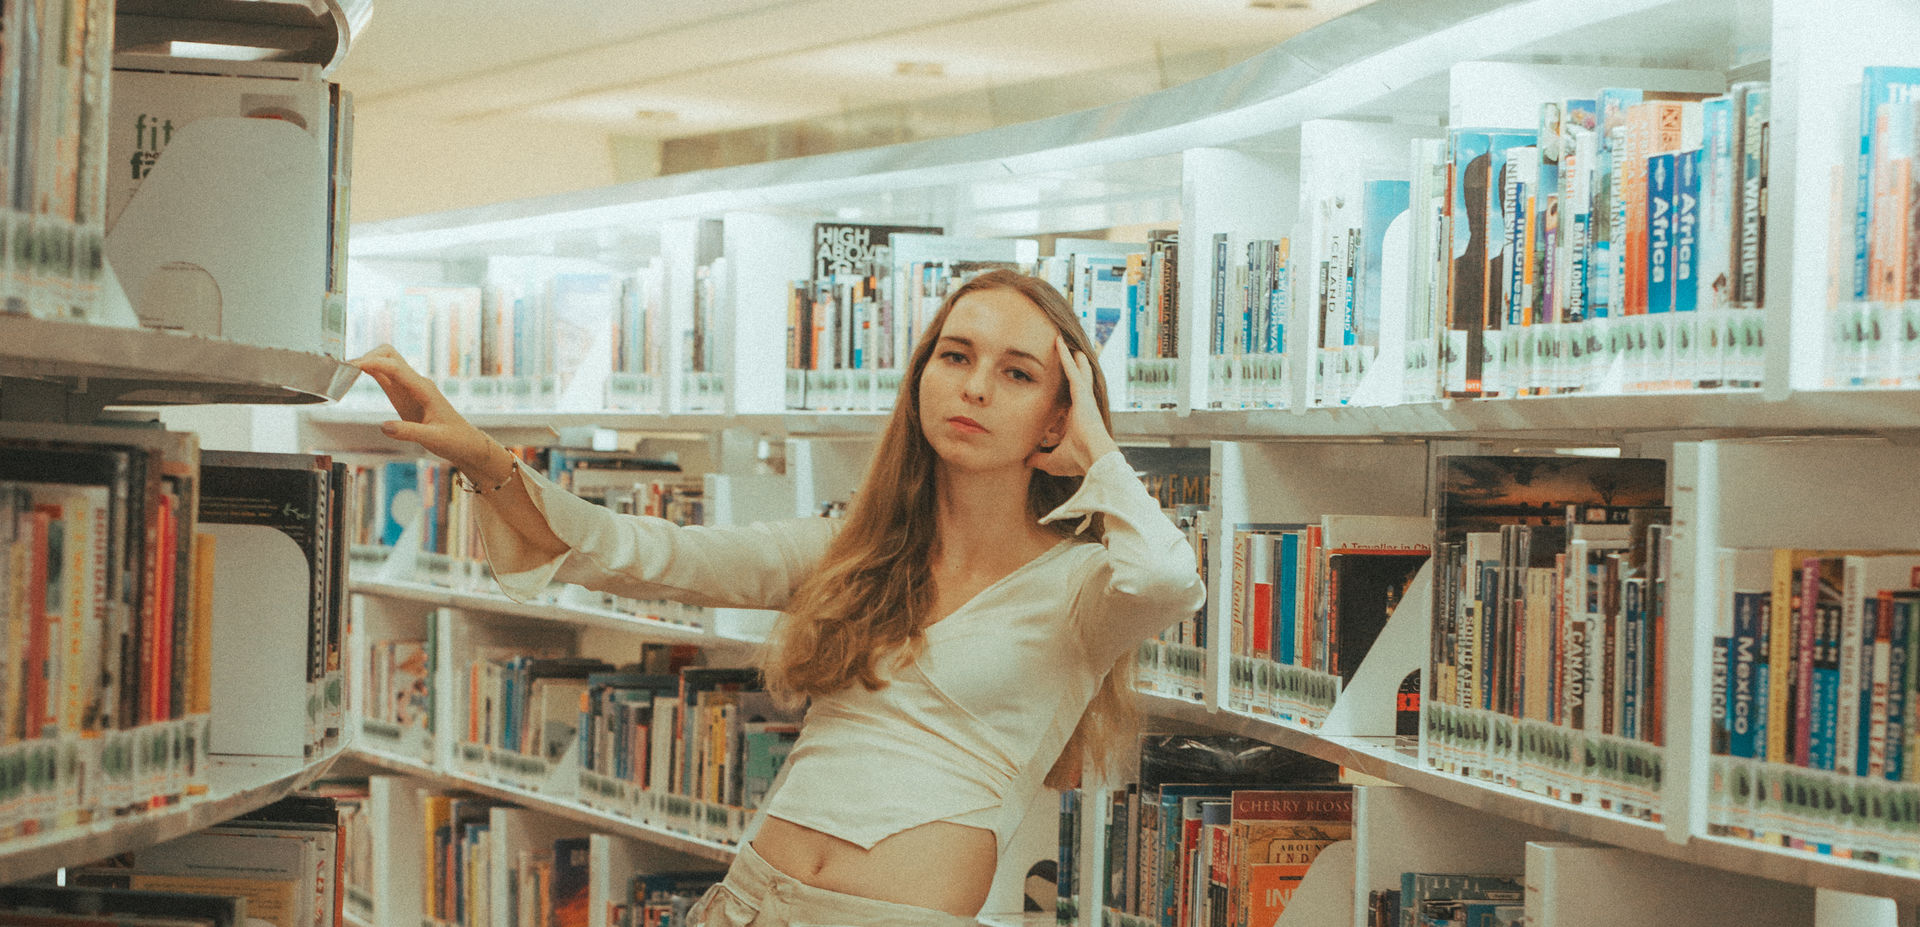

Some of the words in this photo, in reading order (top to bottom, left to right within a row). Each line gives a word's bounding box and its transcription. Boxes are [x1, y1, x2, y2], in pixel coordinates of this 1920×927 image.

[136, 113, 175, 150] fit
[817, 227, 870, 247] HIGH
[1652, 196, 1670, 284] Africa
[1679, 193, 1697, 281] Africa
[1742, 177, 1759, 275] WALKING
[1328, 235, 1341, 314] ICELAND
[1344, 280, 1354, 331] ICELAND
[1511, 218, 1525, 324] Indonesia
[1463, 615, 1475, 665] SOUTH
[1572, 629, 1585, 708] CANADA
[1583, 618, 1597, 694] Canada
[1711, 646, 1729, 722] MEXICO
[1734, 636, 1756, 736] Mexico
[1870, 682, 1888, 779] BELIZE
[1239, 800, 1300, 813] CHERRY
[1306, 800, 1351, 812] BLOSS
